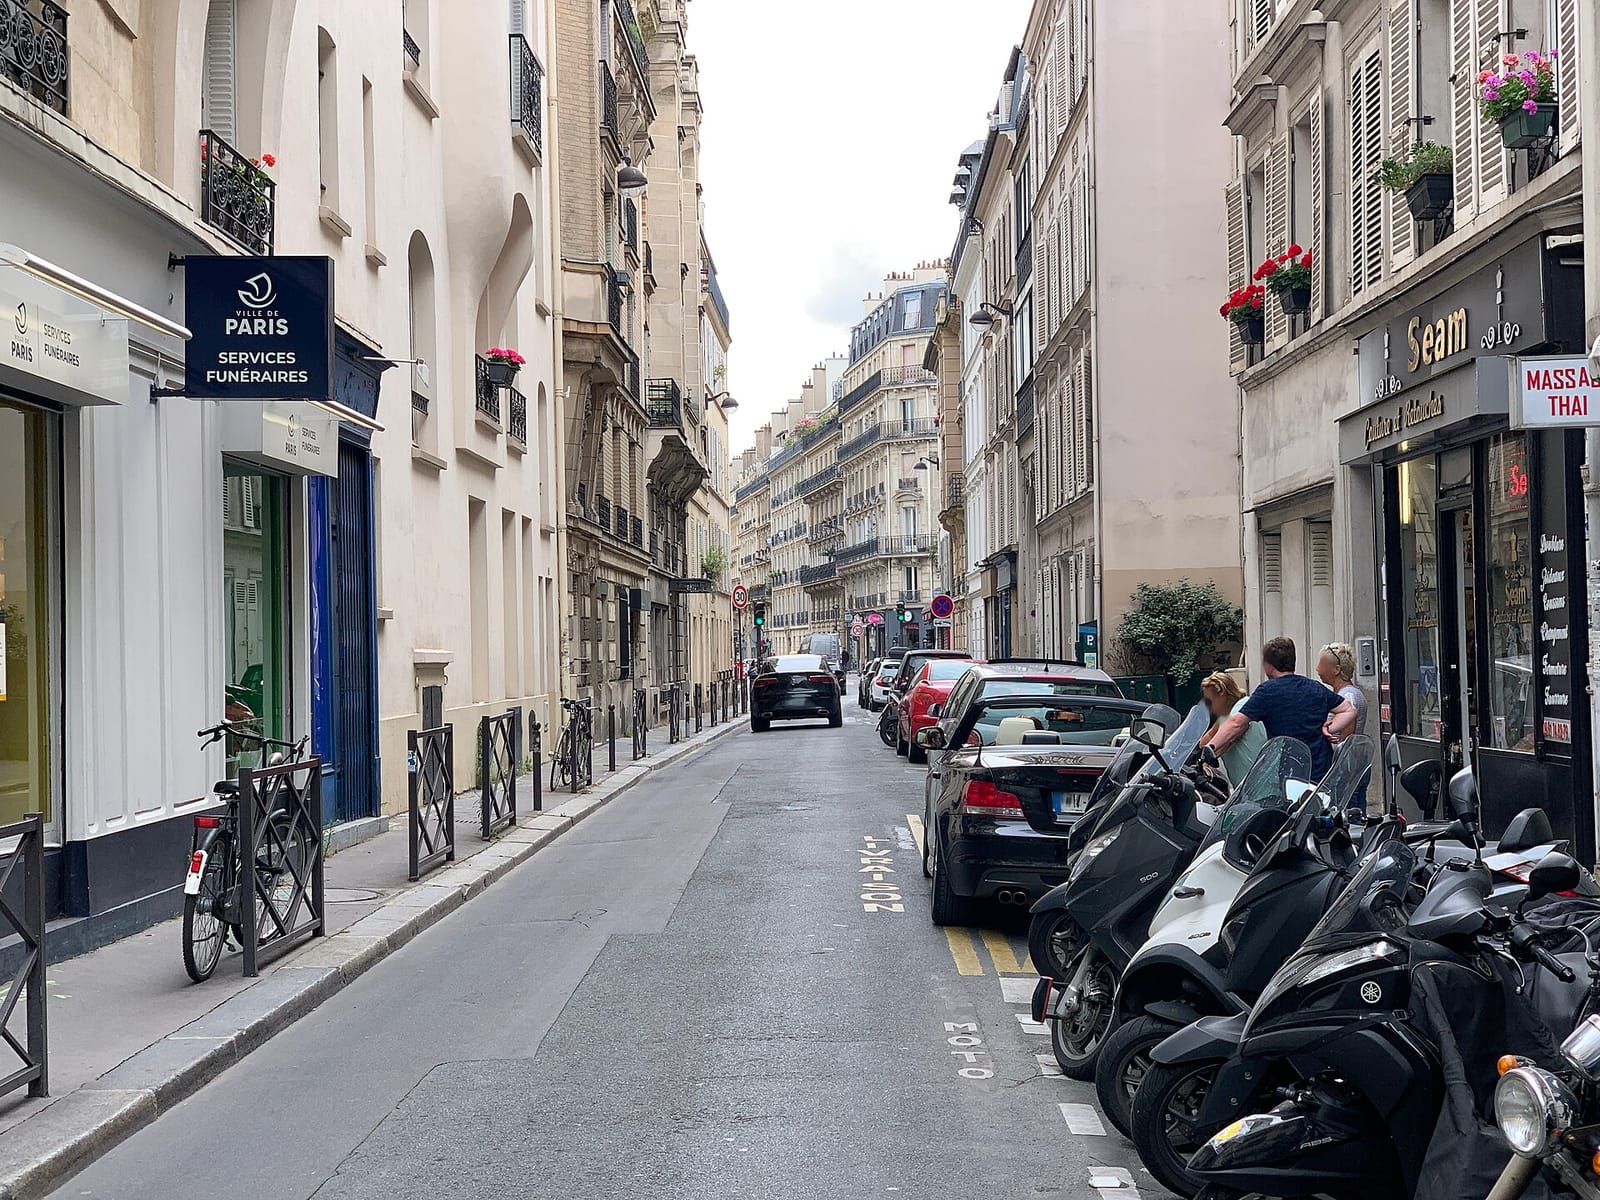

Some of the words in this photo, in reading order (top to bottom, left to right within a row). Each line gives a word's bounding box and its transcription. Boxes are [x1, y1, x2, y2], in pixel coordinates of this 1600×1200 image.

[43, 323, 72, 345] SERVICES
[225, 318, 289, 335] PARIS
[1407, 307, 1468, 373] Seam
[11, 340, 33, 363] PARIS
[44, 343, 80, 367] FUNÉRAIRES
[218, 352, 296, 364] SERVICES
[206, 368, 309, 383] FUNÉRAIRES
[1547, 395, 1588, 416] THAI
[1364, 416, 1393, 450] Couture
[1392, 406, 1403, 434] et
[1404, 390, 1445, 428] Retouches
[735, 590, 745, 603] 30
[857, 835, 905, 912] LIVRAISON
[1140, 871, 1159, 884] 500
[943, 1022, 995, 1079] MOTO
[1300, 1136, 1333, 1149] ABS
